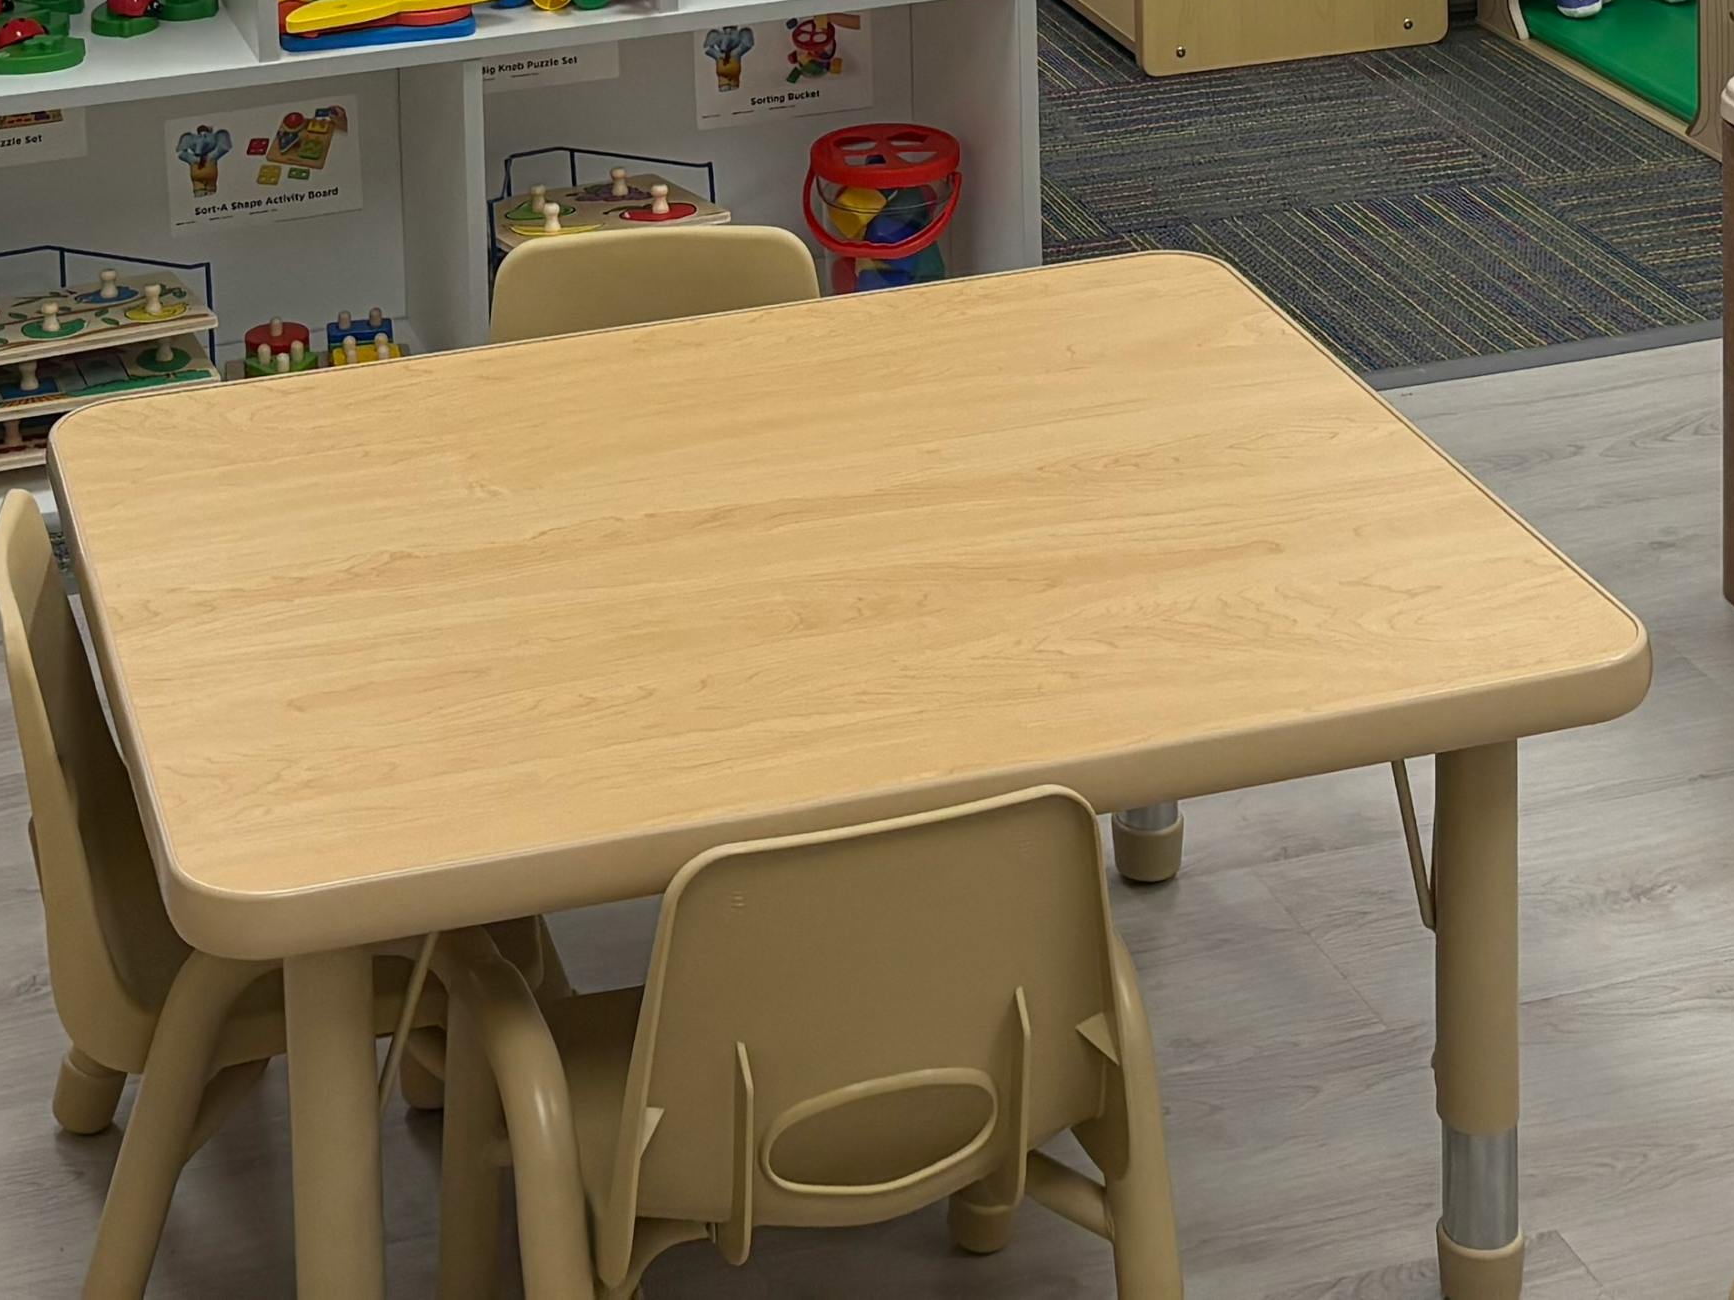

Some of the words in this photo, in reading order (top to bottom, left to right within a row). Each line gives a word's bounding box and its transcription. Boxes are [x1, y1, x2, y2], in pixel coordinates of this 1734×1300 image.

[526, 57, 559, 69] Puzzle
[561, 56, 578, 65] Set
[750, 93, 785, 106] Sorting
[788, 89, 820, 101] Bucket
[25, 135, 43, 144] Set
[231, 199, 263, 212] Shape
[265, 192, 306, 206] Activity
[308, 186, 339, 199] Board
